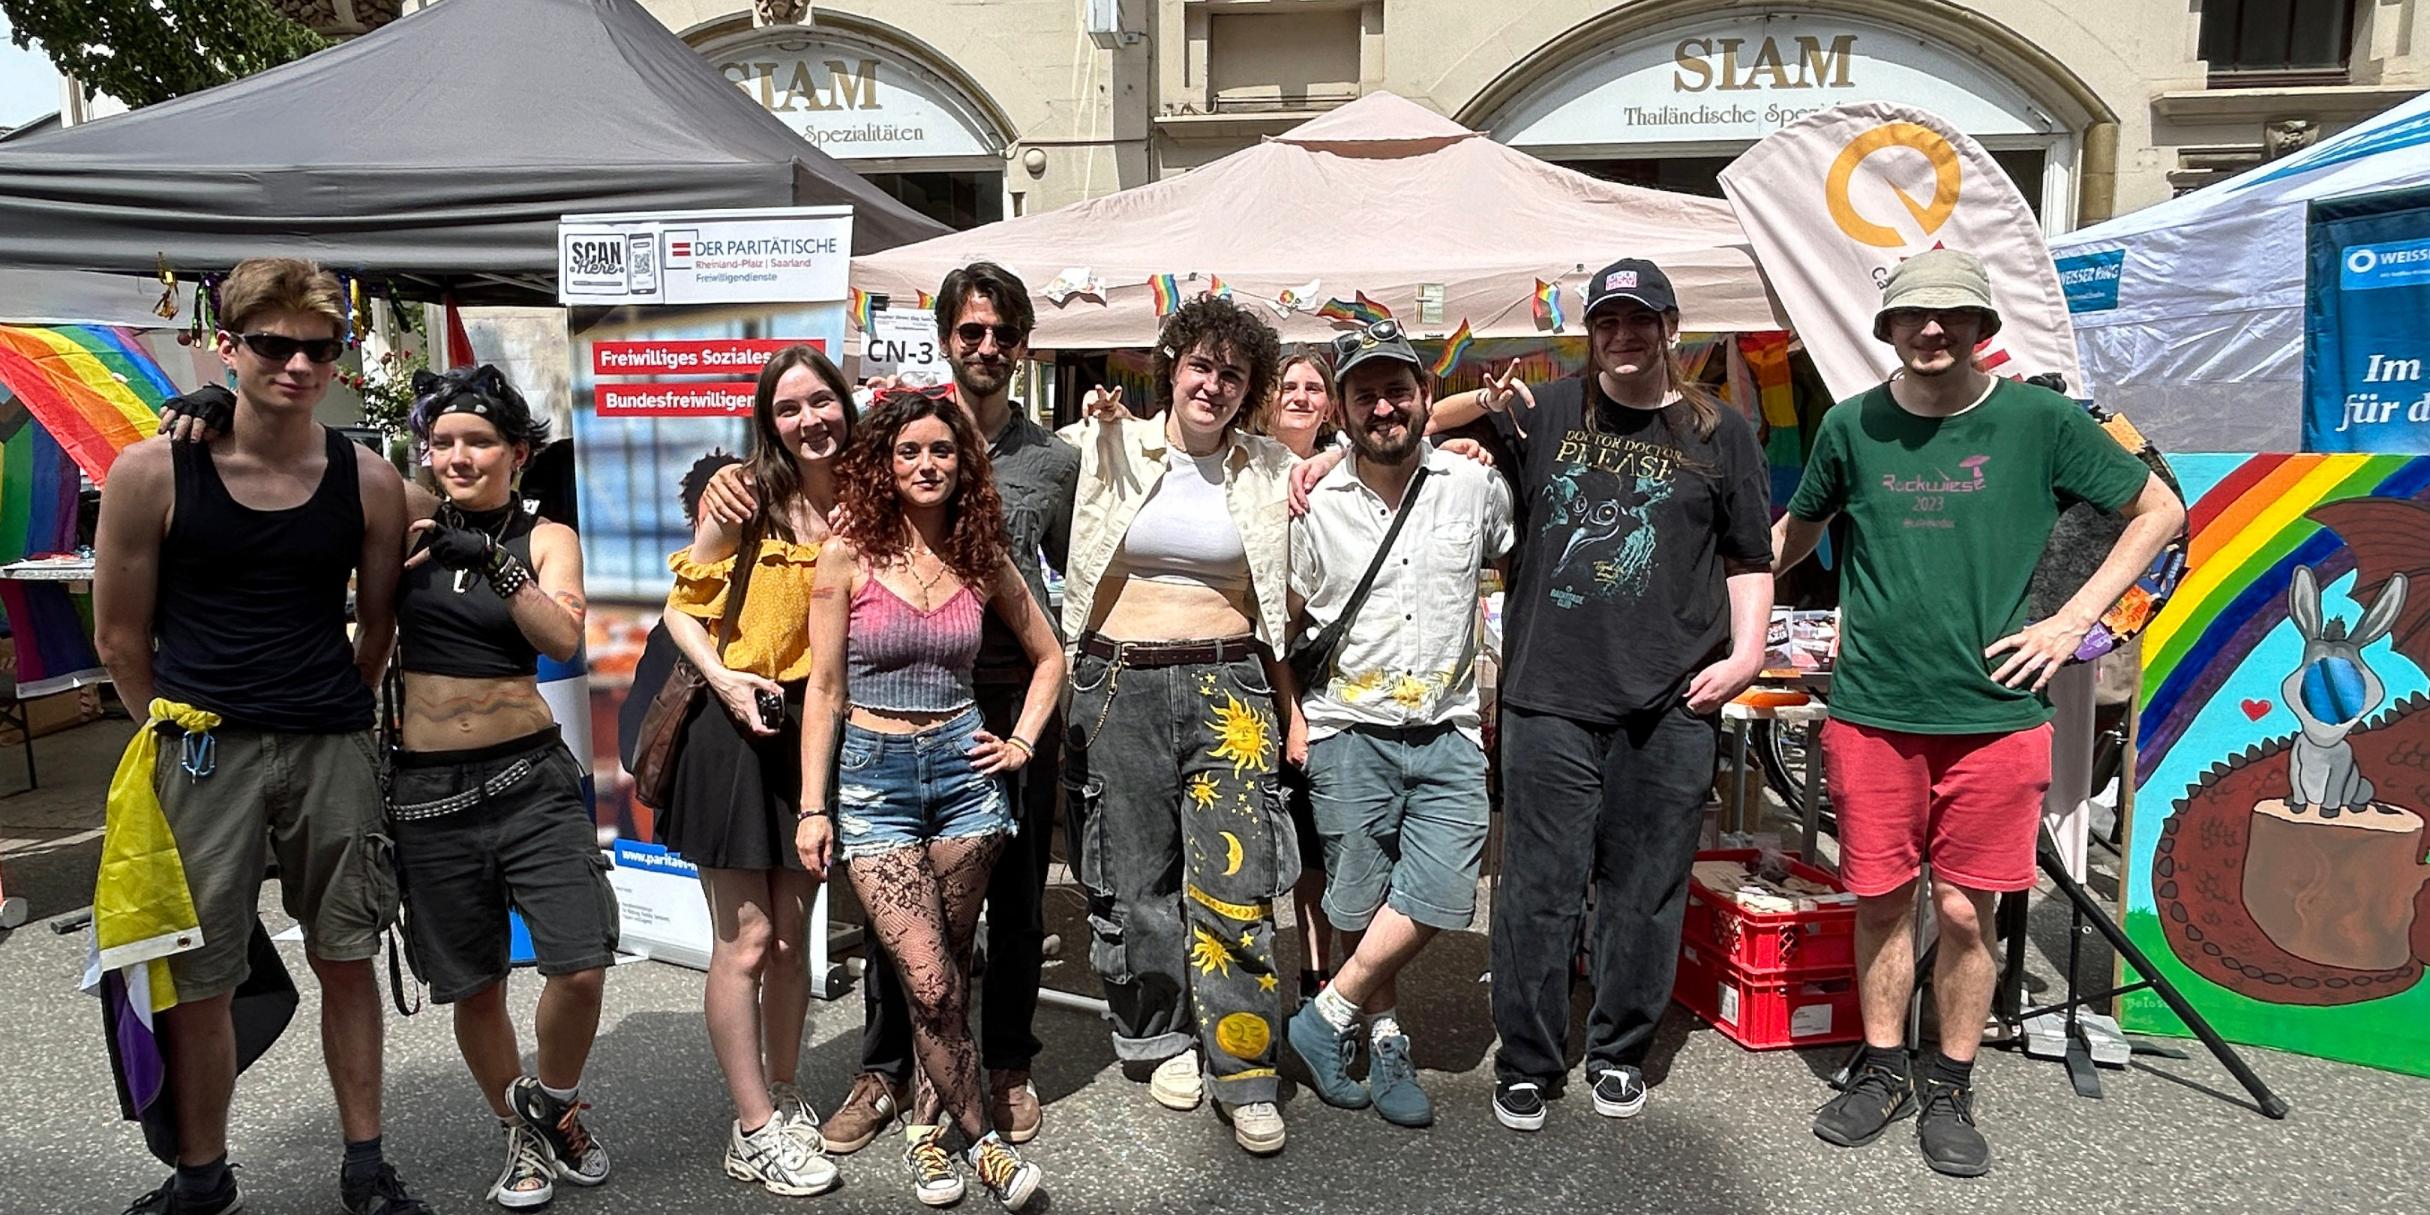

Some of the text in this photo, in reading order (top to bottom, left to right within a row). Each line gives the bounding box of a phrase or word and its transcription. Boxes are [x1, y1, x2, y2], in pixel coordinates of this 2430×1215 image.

[1674, 34, 1858, 93] SIAM
[1624, 104, 1757, 126] Thailändische
[803, 122, 924, 149] Spezialitäten
[572, 241, 622, 265] SCAN
[695, 236, 838, 257] DER PARITÄTISCHE
[2381, 248, 2430, 265] WEISS
[576, 258, 619, 275] Here
[695, 258, 812, 269] Rheinland-Pfalz Saarland
[696, 272, 778, 284] Freiwilligendienste
[601, 347, 773, 369] Freiwilliges Soziales
[867, 339, 934, 365] CN-3
[2362, 354, 2421, 382] Im
[2335, 393, 2400, 432] für
[1566, 430, 1683, 460] DOCTOR DOCTOR
[1555, 440, 1679, 483] PLEASE
[1912, 495, 1945, 512] 2023
